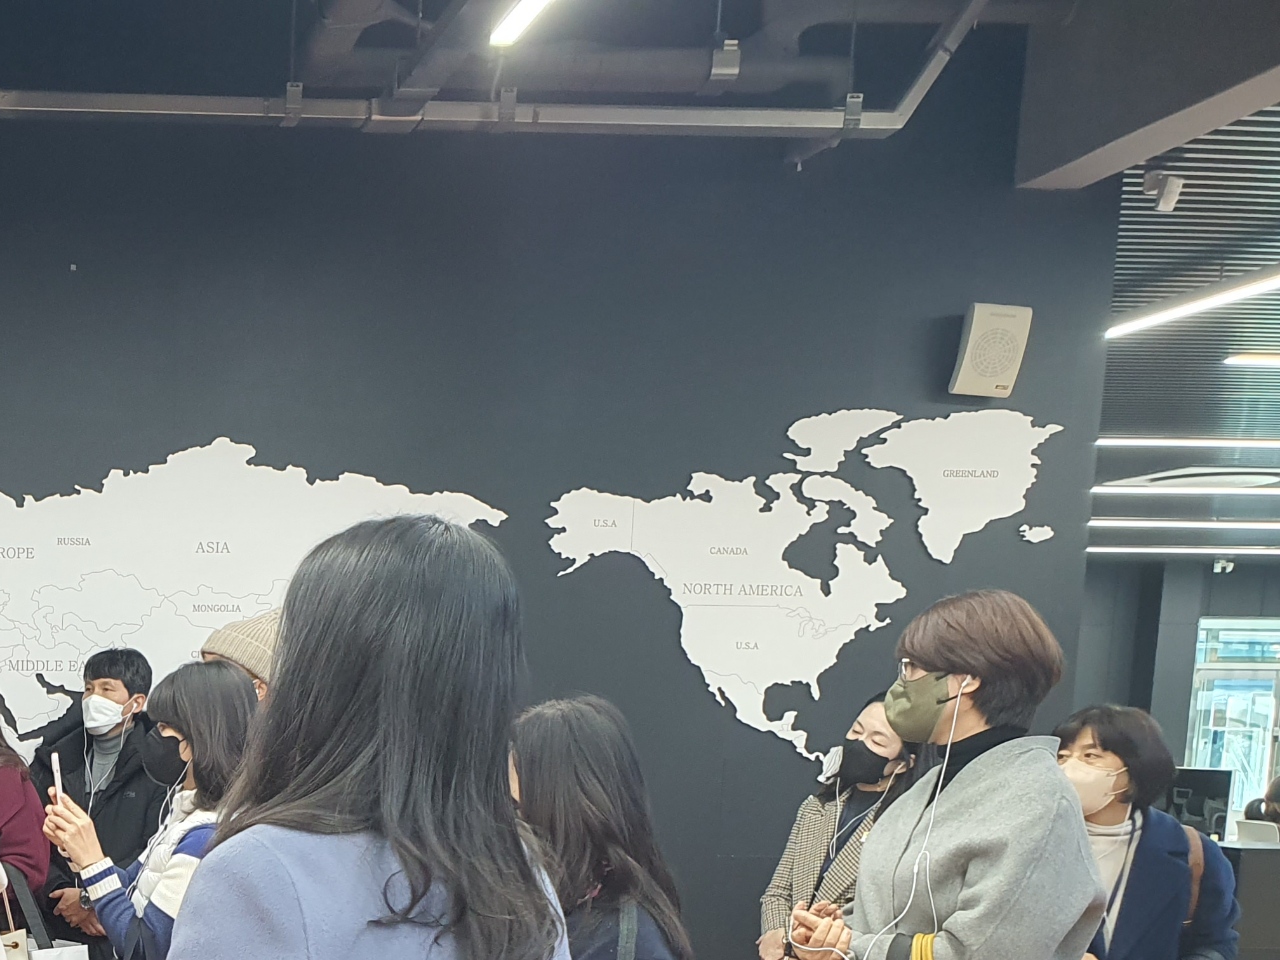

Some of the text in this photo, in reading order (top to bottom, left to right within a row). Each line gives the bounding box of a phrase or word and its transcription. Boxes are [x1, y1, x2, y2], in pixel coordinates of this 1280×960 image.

[942, 469, 1000, 479] GREENLAND
[593, 519, 618, 528] U.S.A
[56, 537, 91, 546] RUSSIA
[195, 541, 231, 554] ASIA
[709, 546, 749, 556] CANADA
[682, 583, 804, 597] NORTH AMERICA
[192, 604, 242, 613] MONGOLIA
[735, 641, 760, 650] U.S.A
[8, 660, 86, 672] MIDDLE EA
